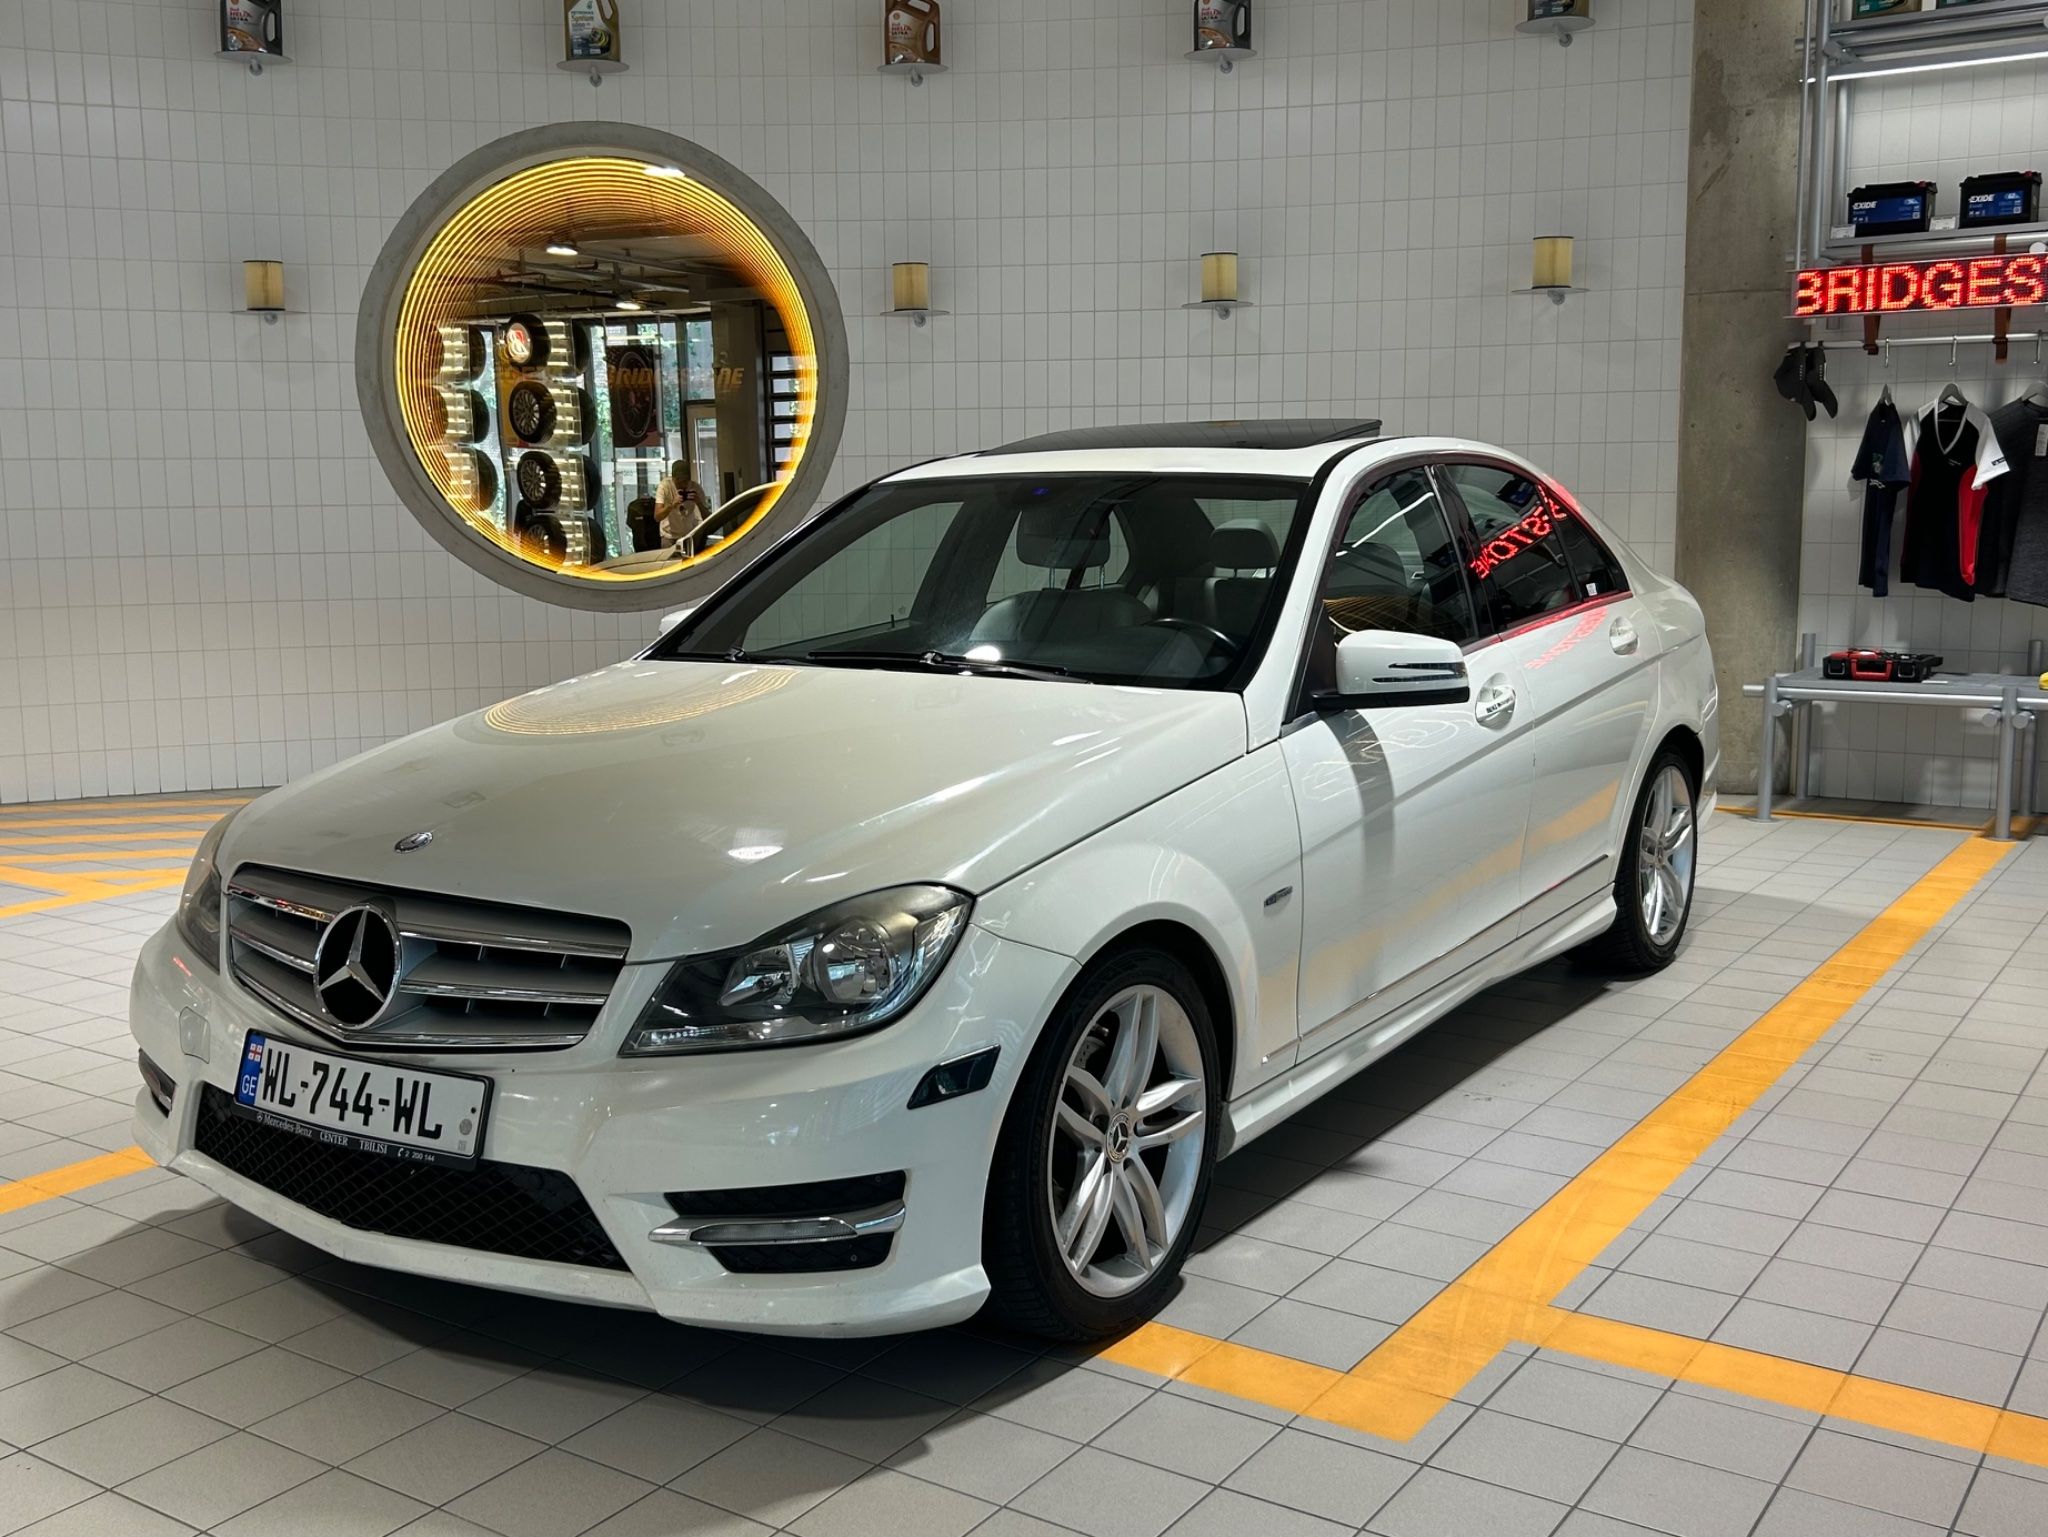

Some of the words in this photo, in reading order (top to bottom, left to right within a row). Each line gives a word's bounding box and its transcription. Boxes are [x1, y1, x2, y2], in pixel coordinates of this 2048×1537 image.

[1853, 201, 1878, 210] EXIDE
[1968, 194, 1996, 203] EXIDE
[1795, 256, 2048, 316] BRIDGES
[241, 1074, 258, 1097] GE
[262, 1048, 443, 1140] WL-744-WL
[262, 1113, 313, 1138] Mercedes-Benz
[320, 1131, 349, 1146] CENTER
